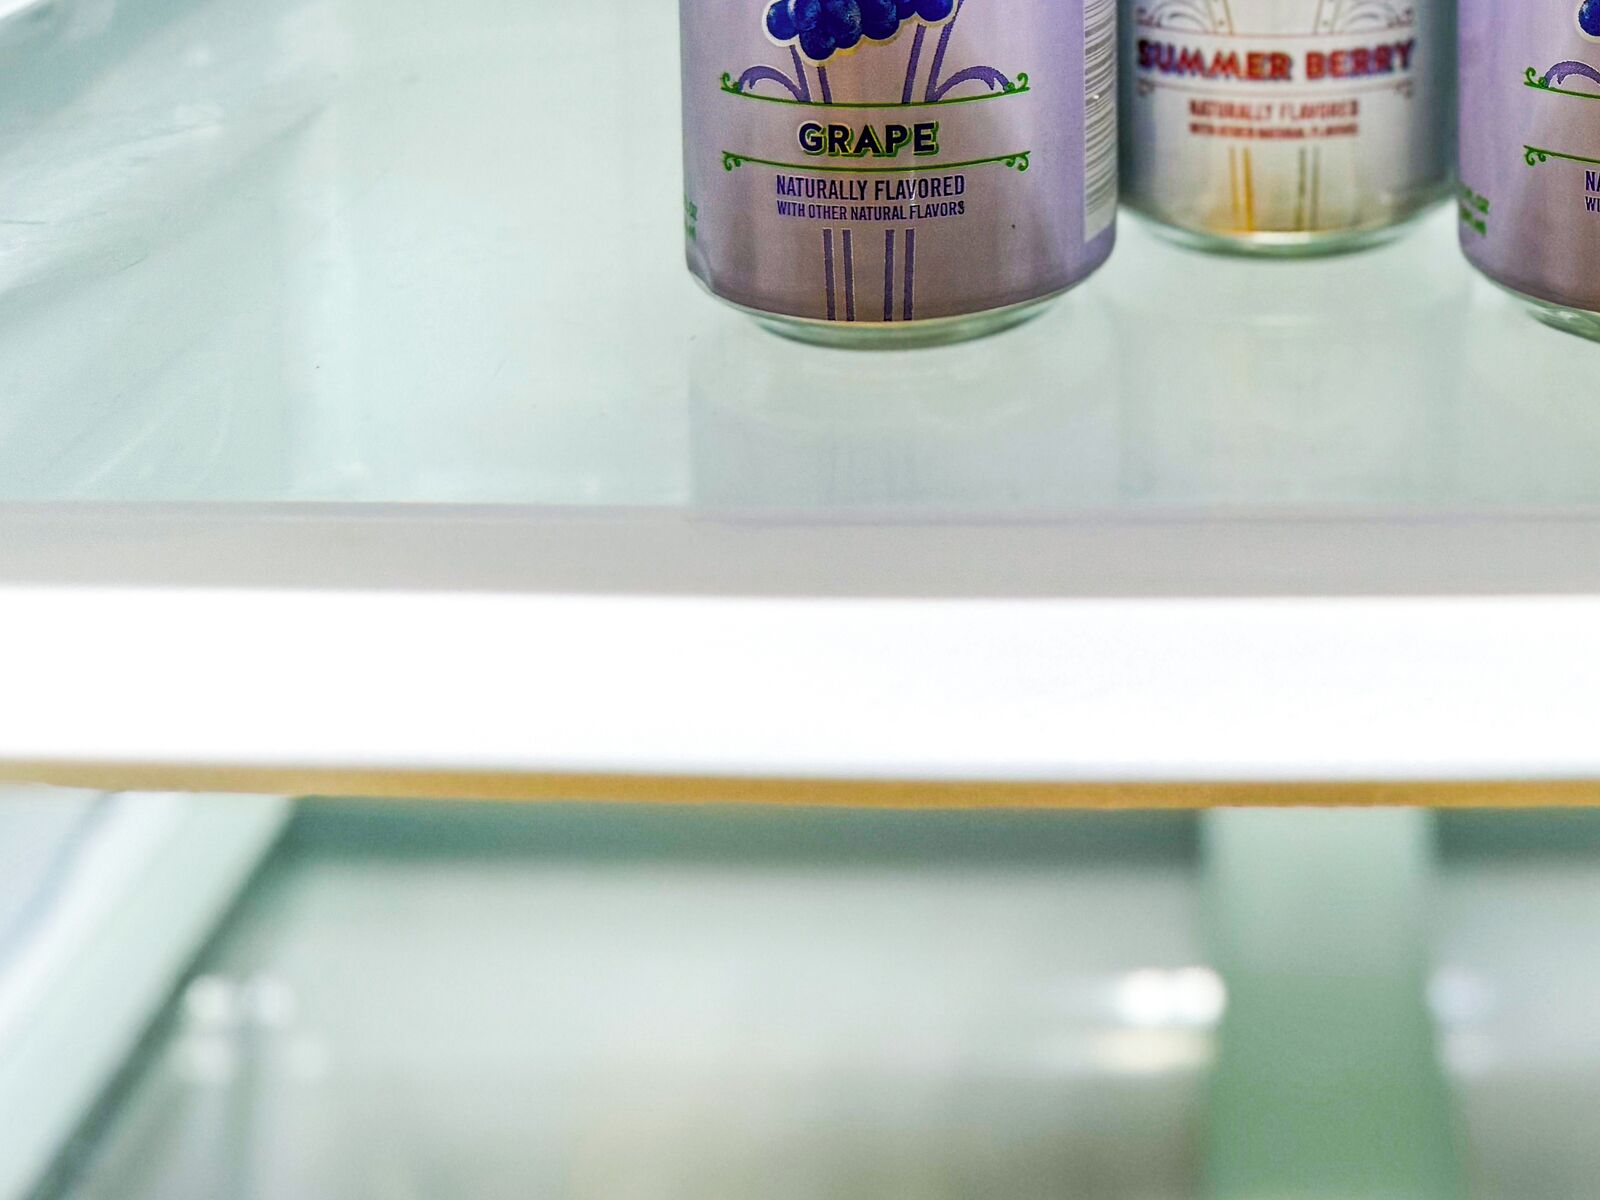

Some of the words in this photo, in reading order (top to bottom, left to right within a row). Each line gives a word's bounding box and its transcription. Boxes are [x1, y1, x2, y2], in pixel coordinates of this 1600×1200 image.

[1137, 38, 1293, 81] SUMMER
[1305, 38, 1416, 81] BERRY
[798, 120, 940, 158] GRAPE
[776, 174, 868, 201] NATURALLY
[874, 175, 965, 201] FLAVORED
[777, 200, 805, 217] WITH
[809, 204, 847, 220] OTHER
[851, 205, 907, 221] NATURAL
[909, 201, 965, 220] FLAVORS
